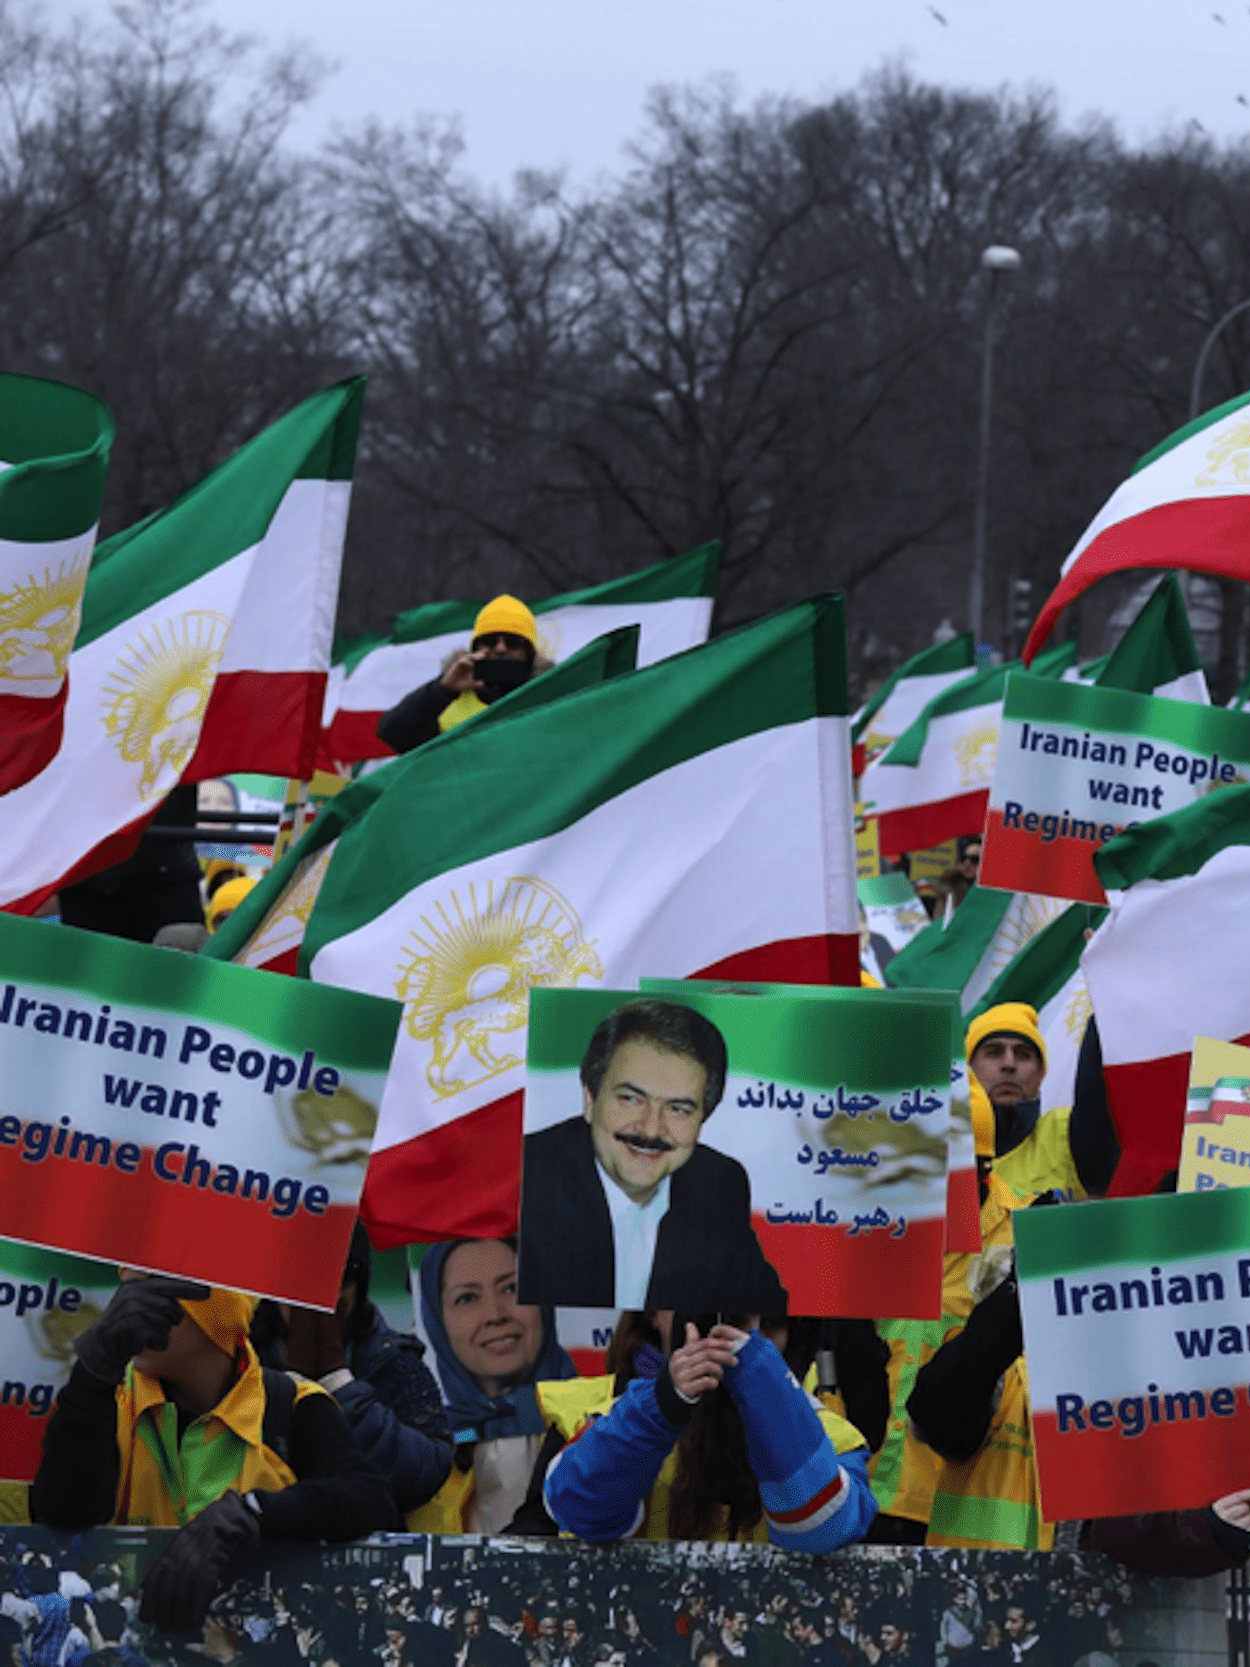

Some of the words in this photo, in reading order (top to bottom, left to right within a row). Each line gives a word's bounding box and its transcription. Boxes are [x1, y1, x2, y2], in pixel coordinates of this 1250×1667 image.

[1020, 723, 1127, 766] Iranian
[1134, 744, 1237, 784] People
[1088, 778, 1165, 811] want
[1003, 802, 1116, 845] Regime
[0, 984, 168, 1059] Iranian
[179, 1023, 341, 1097] People
[103, 1071, 221, 1130] want
[737, 1081, 806, 1118] بداند
[812, 1083, 881, 1121] جهان
[888, 1088, 944, 1122] خلق
[0, 1114, 142, 1172] egime
[152, 1141, 331, 1218] Change
[796, 1144, 881, 1175] مسعود
[766, 1198, 840, 1228] ماست
[846, 1204, 908, 1238] رهبر
[0, 1276, 83, 1317] ople
[1053, 1266, 1225, 1317] Iranian
[1054, 1383, 1237, 1437] Regime
